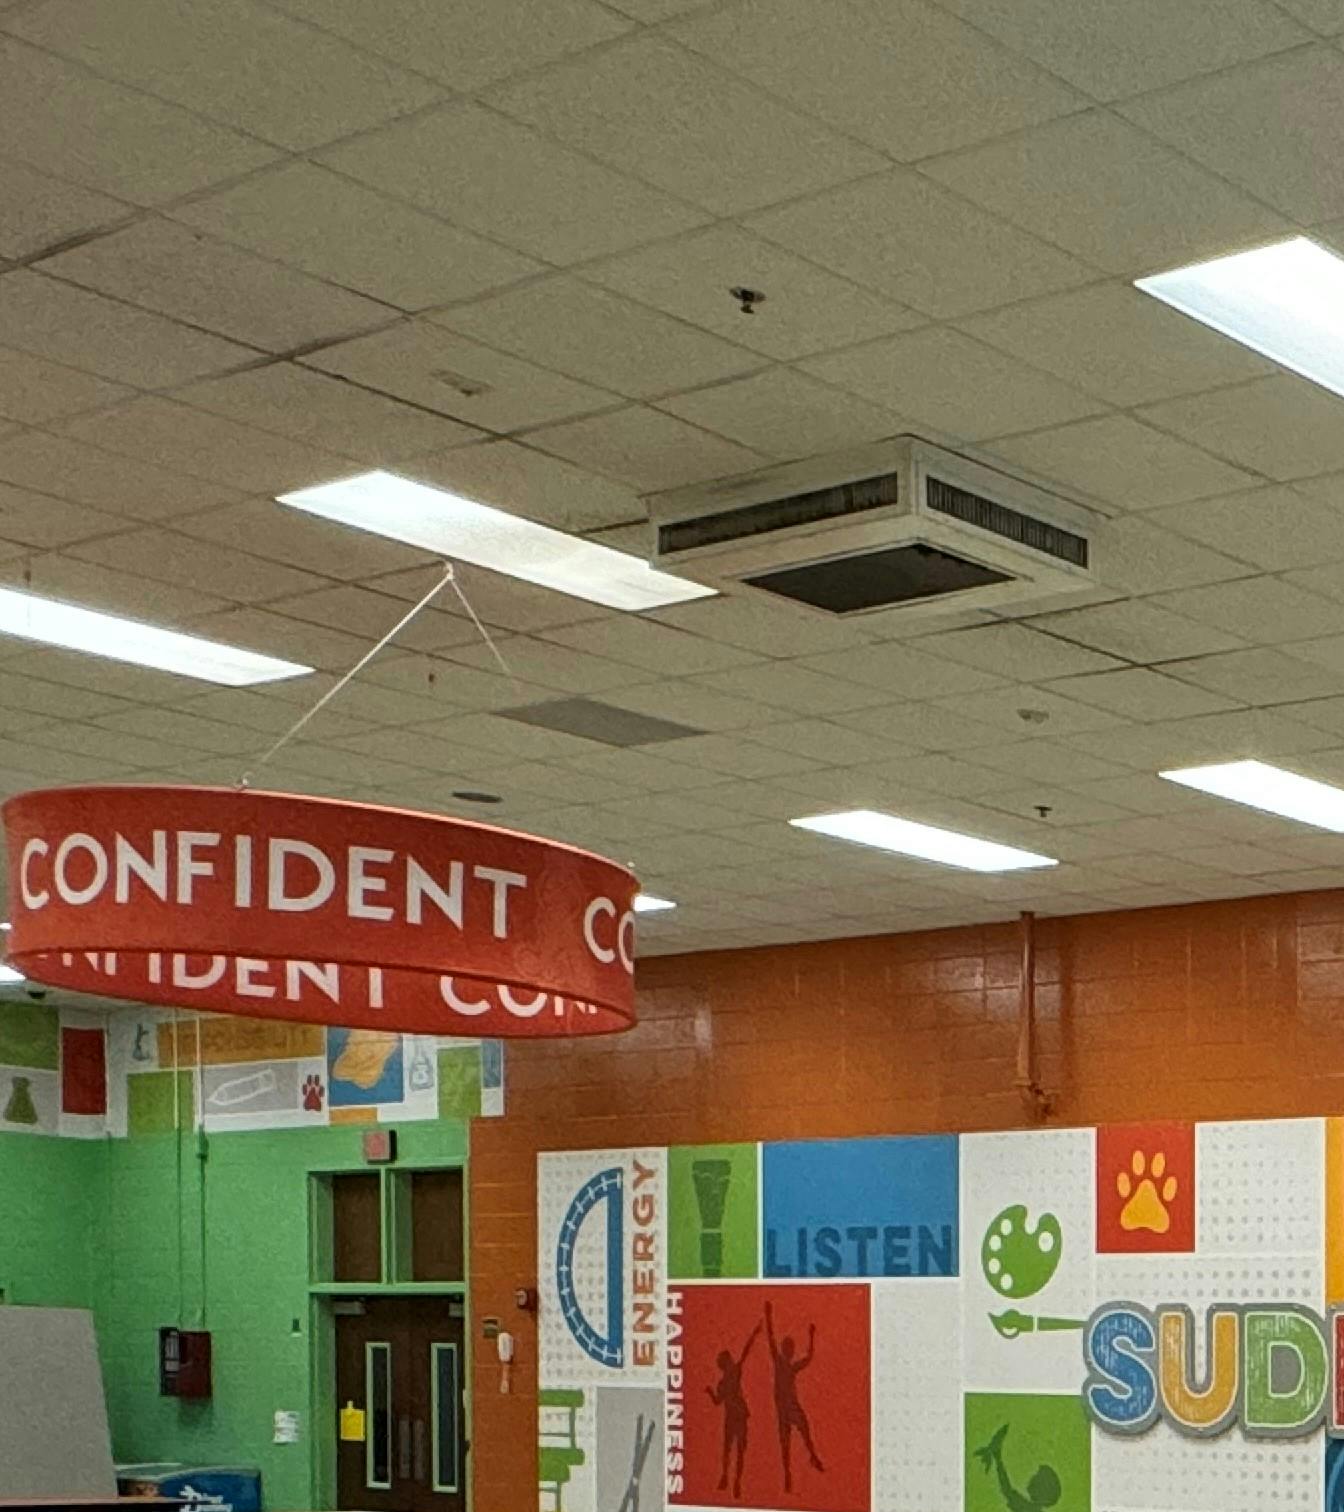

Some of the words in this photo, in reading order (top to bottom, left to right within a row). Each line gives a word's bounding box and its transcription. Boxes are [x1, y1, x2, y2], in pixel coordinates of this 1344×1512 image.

[20, 830, 528, 939] CONFIDENT
[633, 1159, 656, 1367] ENERGY
[765, 1225, 953, 1277] LISTEN
[667, 1291, 684, 1495] HAPPINESS
